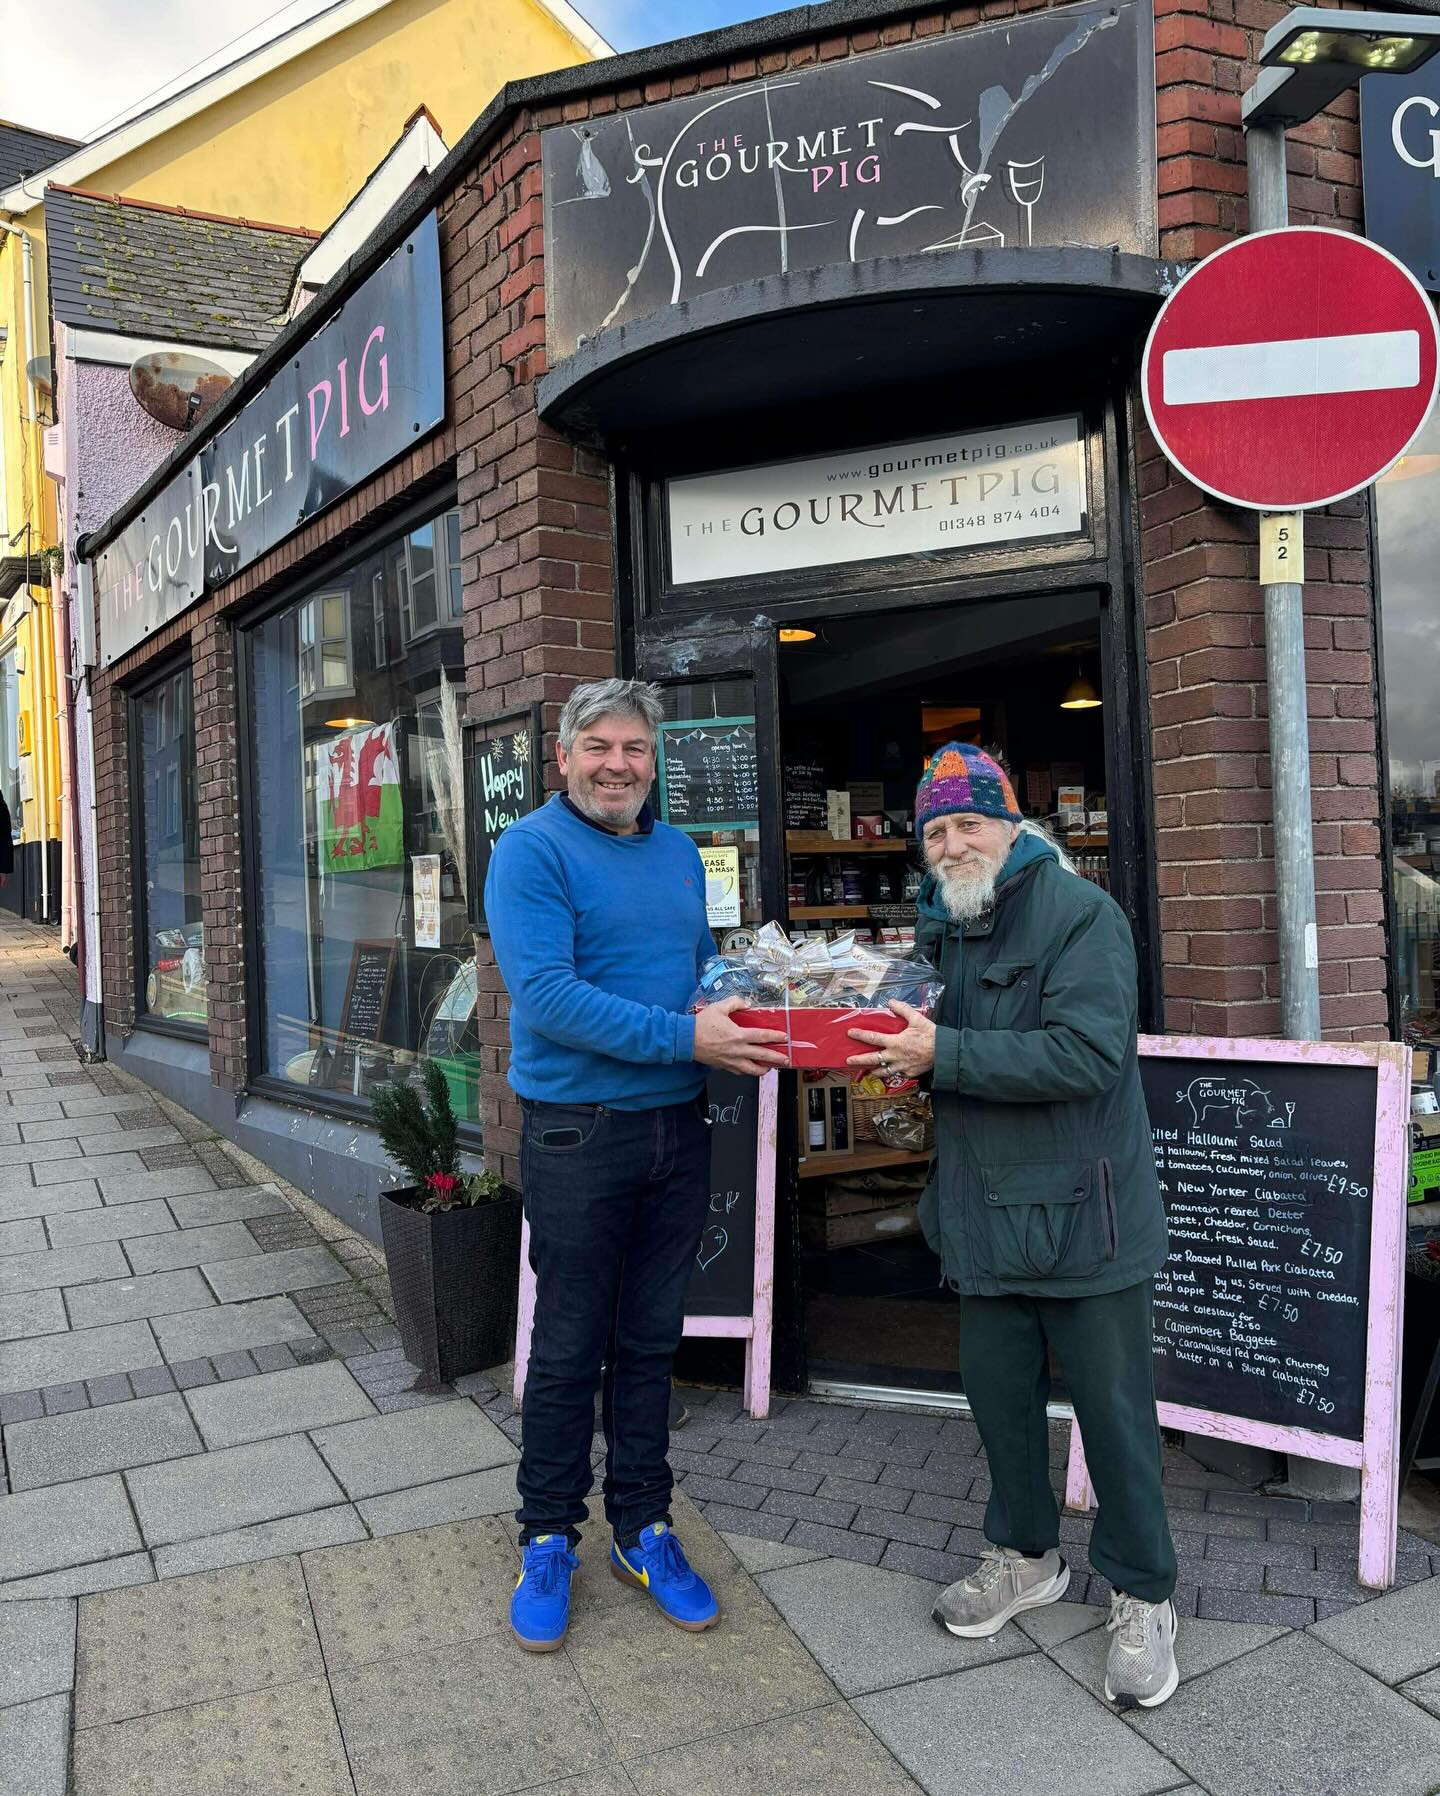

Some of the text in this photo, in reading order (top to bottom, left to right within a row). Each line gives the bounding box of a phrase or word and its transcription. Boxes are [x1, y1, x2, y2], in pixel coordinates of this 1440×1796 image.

[675, 118, 883, 188] GOURMET
[697, 135, 743, 155] THE
[811, 155, 882, 193] PIG
[827, 437, 1058, 481] www.gourmetpig.co.uk
[113, 325, 389, 619] THE GOURMET PIG
[684, 463, 1060, 536] THE GOURMET PIG
[939, 504, 1061, 531] 01348 874 404
[1278, 528, 1288, 541] 5
[1278, 546, 1288, 560] 2
[481, 753, 523, 802] Happy
[485, 806, 520, 832] New
[1200, 1089, 1247, 1100] GOURMET
[1231, 1098, 1245, 1106] PIG
[1152, 1128, 1283, 1148] illed Halloumi Salad
[1154, 1146, 1163, 1154] ed
[1240, 1154, 1269, 1165] mixed
[1155, 1159, 1164, 1167] ed
[1328, 1174, 1368, 1197] £9.50
[1178, 1181, 1204, 1192] New
[1209, 1183, 1248, 1196] Yorker
[1255, 1188, 1306, 1201] Ciabatta
[1166, 1216, 1201, 1226] risket,
[1171, 1203, 1304, 1219] mountain reared Dexter
[1215, 1231, 1244, 1245] fresh
[1301, 1238, 1343, 1264] £7.50
[1167, 1249, 1335, 1280] use Roasted Pulled Pork Ciabatta
[1173, 1270, 1196, 1282] bred
[1215, 1276, 1226, 1290] by
[1249, 1279, 1281, 1294] Served
[1287, 1288, 1311, 1298] with
[1153, 1300, 1189, 1312] memade
[1239, 1312, 1254, 1321] for
[1155, 1283, 1172, 1292] and
[1177, 1286, 1205, 1296] apple
[1258, 1294, 1298, 1322] £7.50
[1164, 1318, 1222, 1338] Camembert
[1153, 1333, 1175, 1346] bert,
[1235, 1347, 1249, 1359] red
[1254, 1353, 1280, 1364] onion
[1209, 1358, 1219, 1366] on
[1228, 1361, 1233, 1369] a
[1296, 1388, 1334, 1413] £7.50
